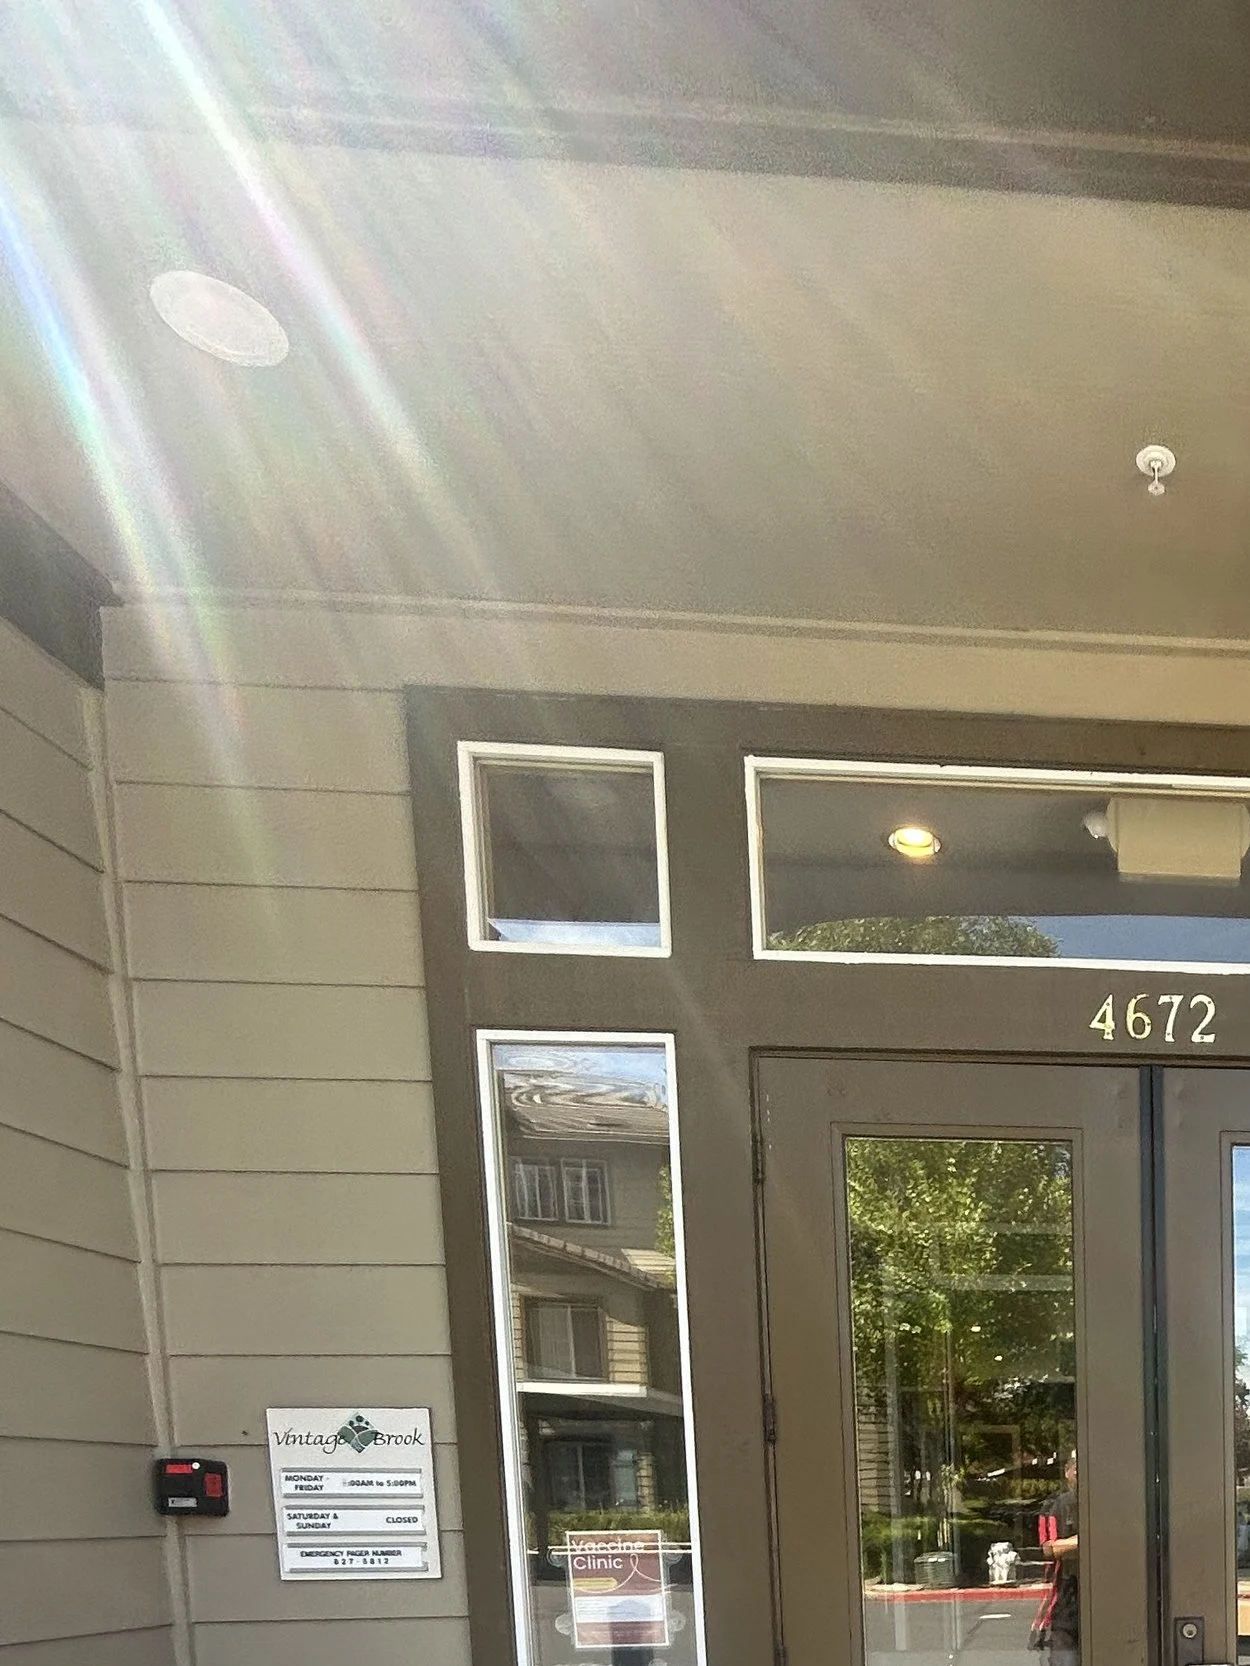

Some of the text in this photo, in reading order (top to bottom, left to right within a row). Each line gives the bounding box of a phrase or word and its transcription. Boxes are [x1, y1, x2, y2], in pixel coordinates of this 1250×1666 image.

[1089, 993, 1217, 1044] 4672
[273, 1427, 426, 1454] Vintage Brook
[386, 1516, 419, 1524] CLOSED
[372, 1549, 402, 1557] NUMBER
[573, 1555, 623, 1570] Clinic
